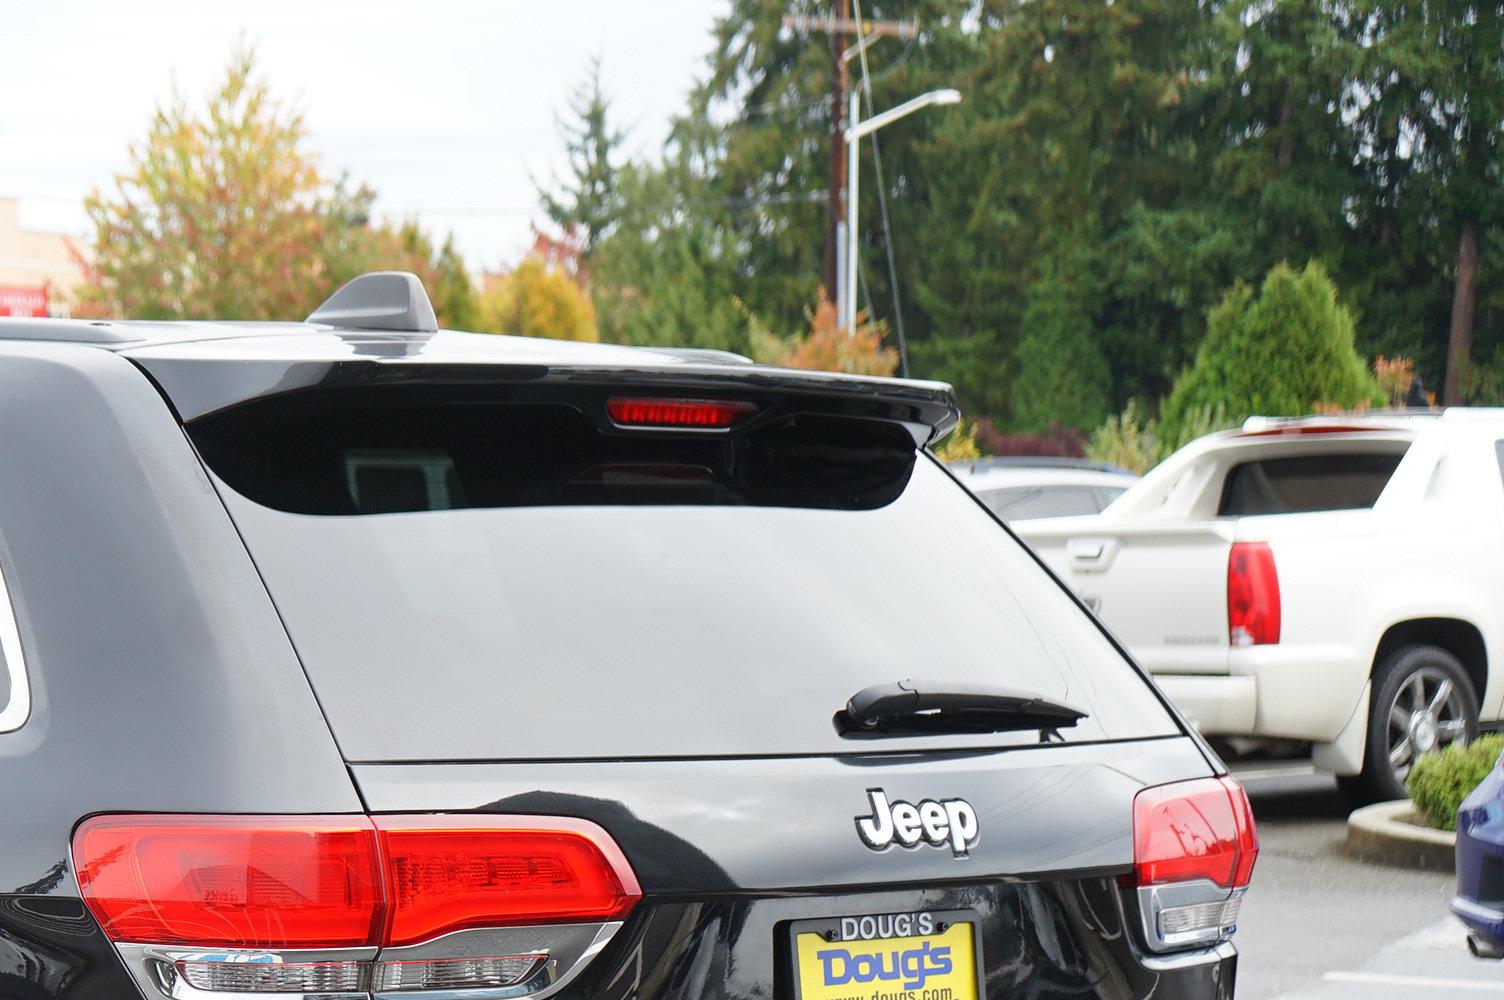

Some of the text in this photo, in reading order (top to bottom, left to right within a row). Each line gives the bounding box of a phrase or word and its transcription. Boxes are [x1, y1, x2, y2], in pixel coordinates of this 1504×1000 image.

[854, 787, 980, 860] Jeep
[841, 912, 933, 941] DOUG'S
[817, 941, 953, 990] Doug's
